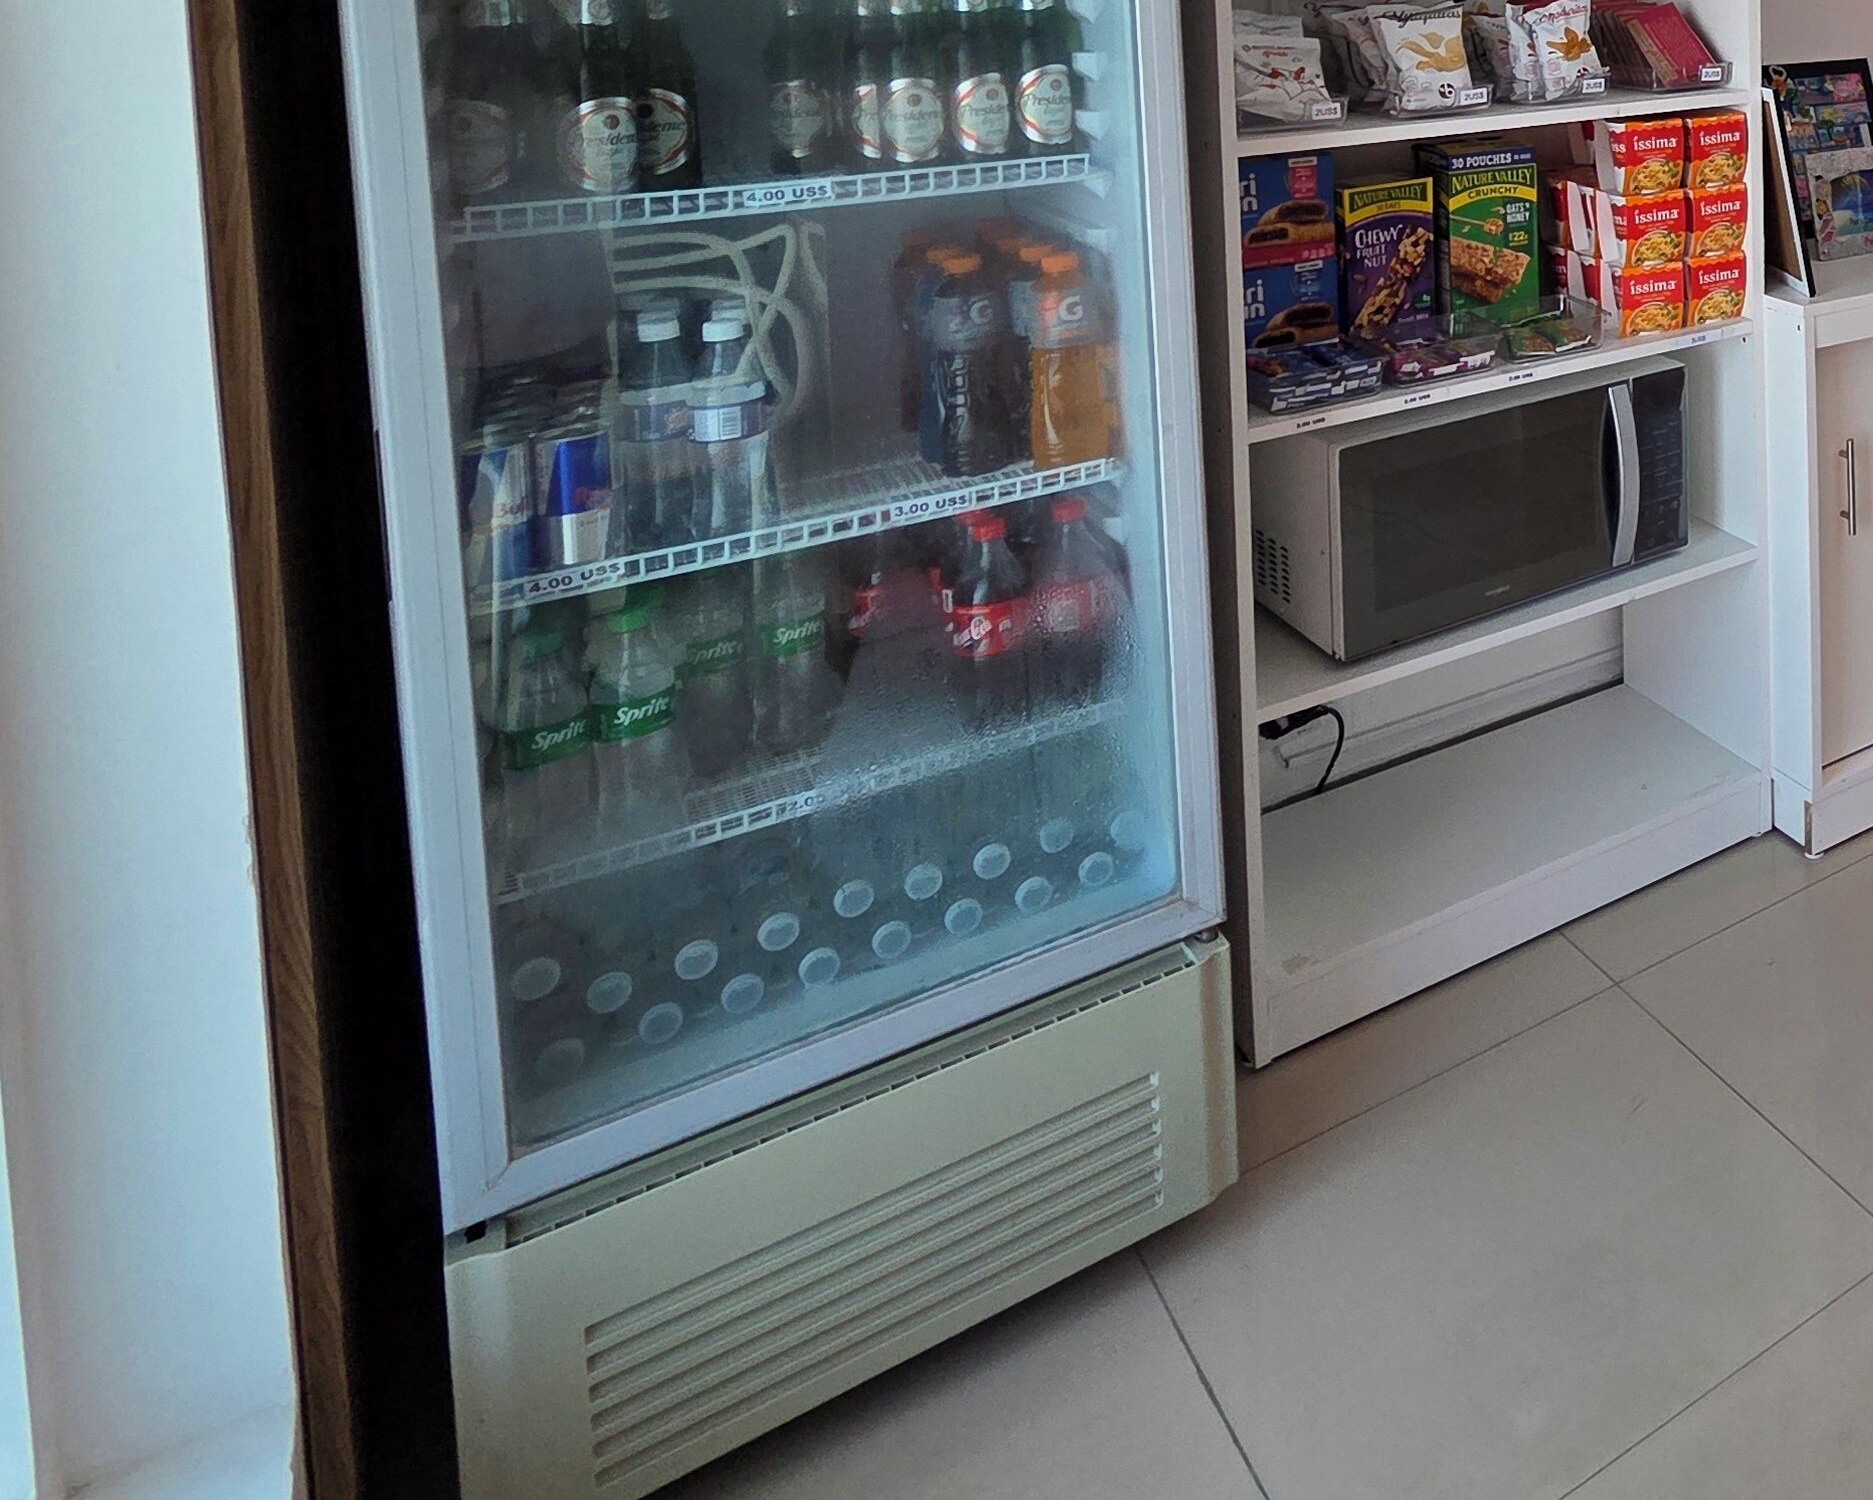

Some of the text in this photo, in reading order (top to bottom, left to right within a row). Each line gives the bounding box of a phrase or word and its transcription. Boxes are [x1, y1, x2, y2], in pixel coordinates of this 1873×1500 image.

[1452, 157, 1465, 169] 30
[1466, 152, 1512, 168] POUCHES
[1451, 168, 1533, 194] NATURE VALLEY
[1468, 186, 1520, 200] CRUNCHY
[746, 185, 828, 203] 4.00 US$
[1351, 184, 1424, 210] NATURE VALLEY
[1506, 202, 1525, 215] OATS
[1506, 211, 1530, 224] HONEY
[1355, 224, 1403, 249] CHEWY
[1356, 244, 1387, 260] FRUIT
[1364, 253, 1387, 269] NUT
[969, 299, 994, 325] G
[1058, 296, 1083, 321] G
[894, 494, 968, 517] 3.00 US$
[528, 562, 622, 594] 4.00 US$
[773, 619, 822, 646] Sprite
[613, 696, 671, 726] Sprite
[531, 717, 586, 751] Sprite
